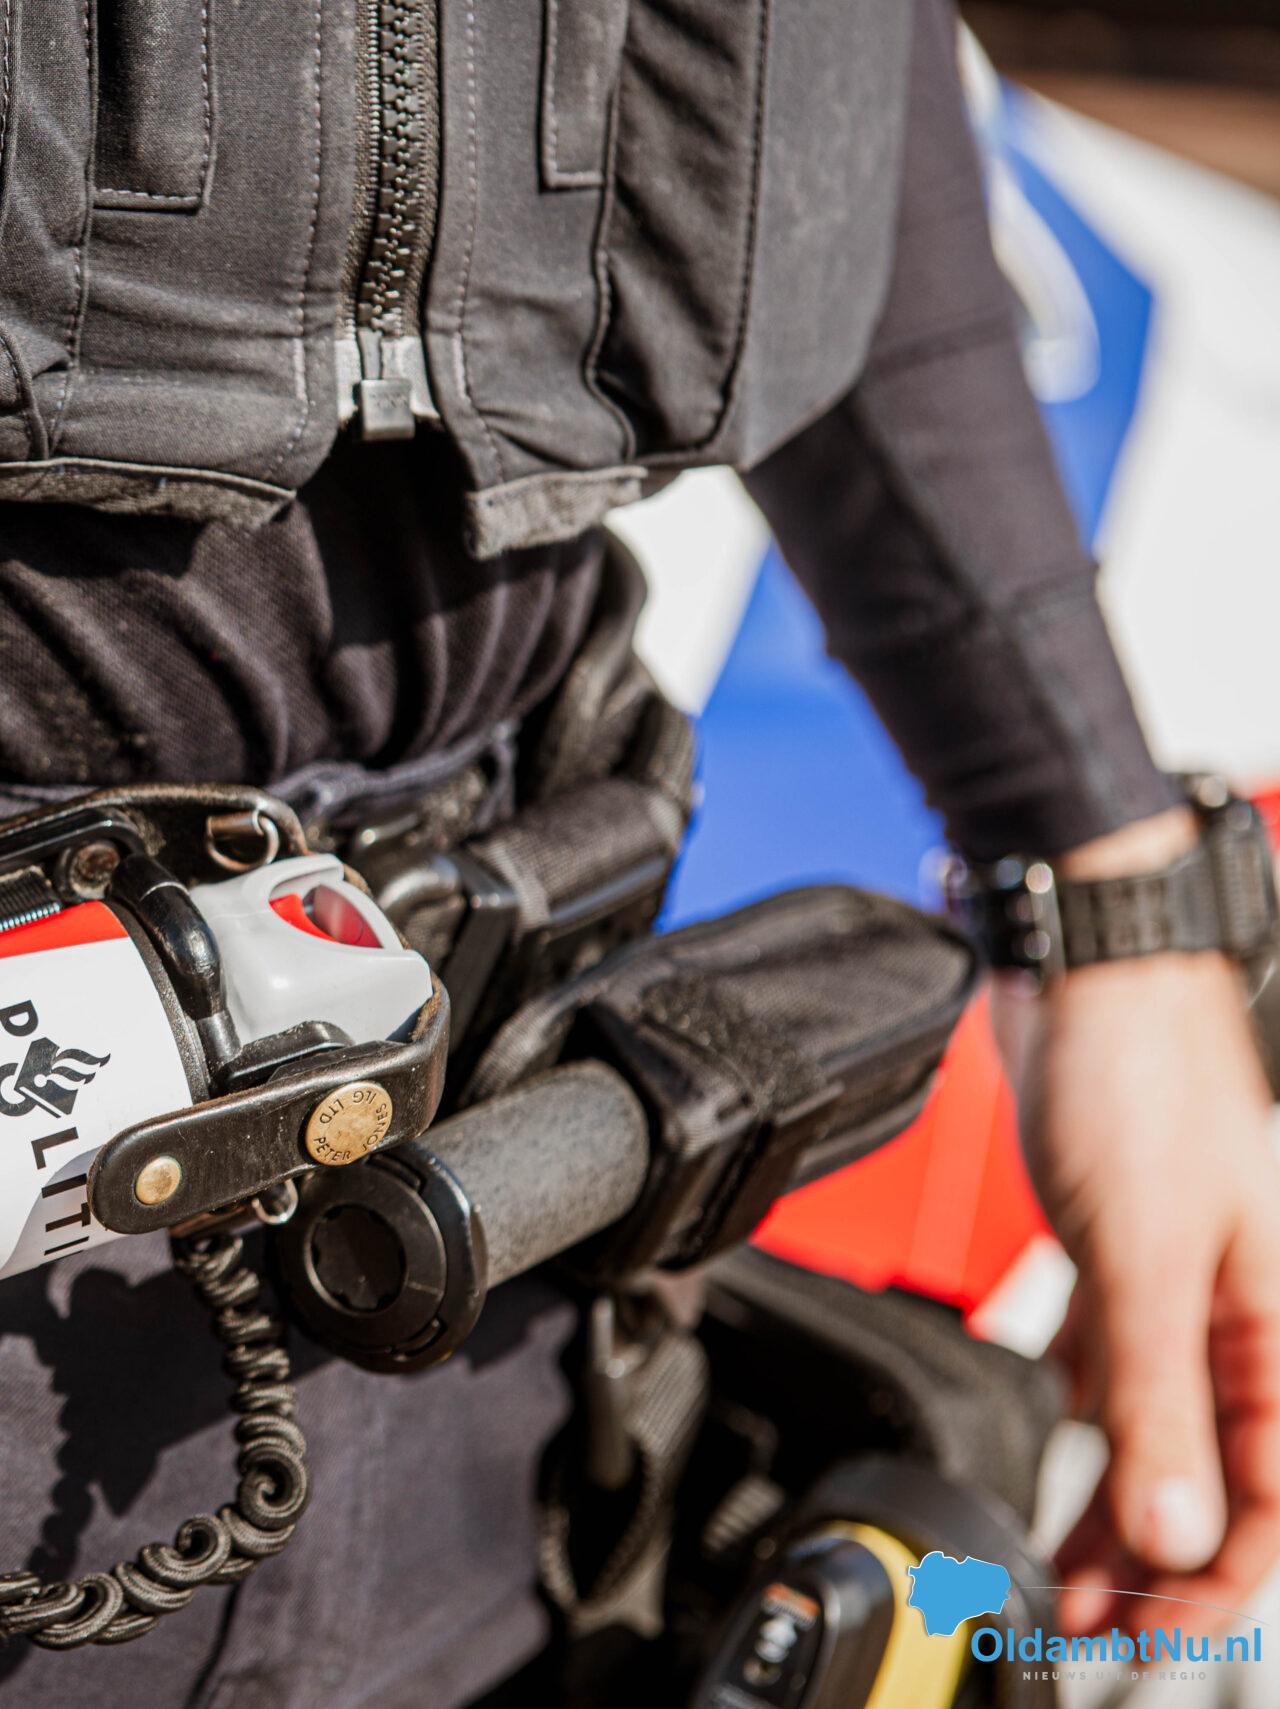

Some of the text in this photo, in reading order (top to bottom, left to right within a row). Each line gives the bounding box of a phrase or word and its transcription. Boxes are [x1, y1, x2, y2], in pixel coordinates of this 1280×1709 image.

[314, 1090, 389, 1161] PETER JONES ILG LTD
